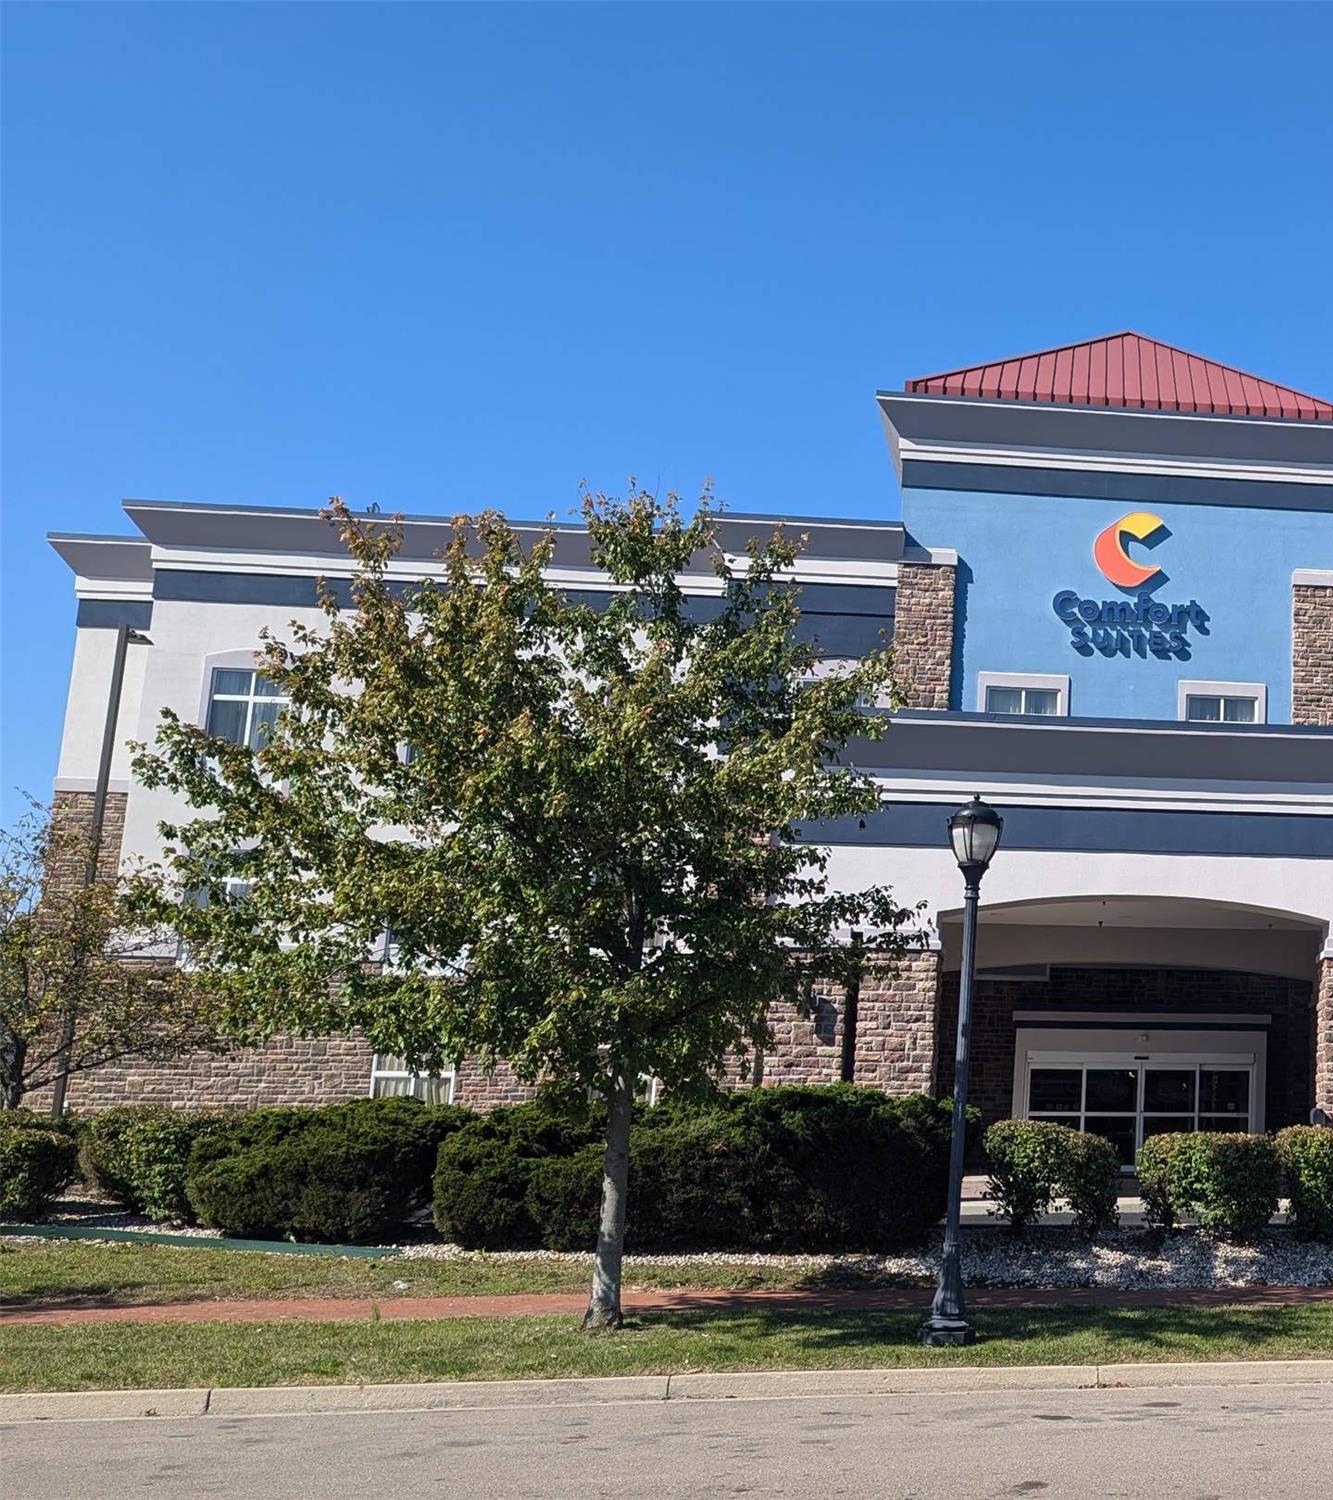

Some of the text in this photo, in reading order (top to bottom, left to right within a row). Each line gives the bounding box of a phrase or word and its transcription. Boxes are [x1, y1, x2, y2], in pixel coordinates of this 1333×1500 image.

[1093, 511, 1166, 588] C
[1052, 590, 1203, 626] Comfort
[1070, 626, 1187, 653] SUITES
